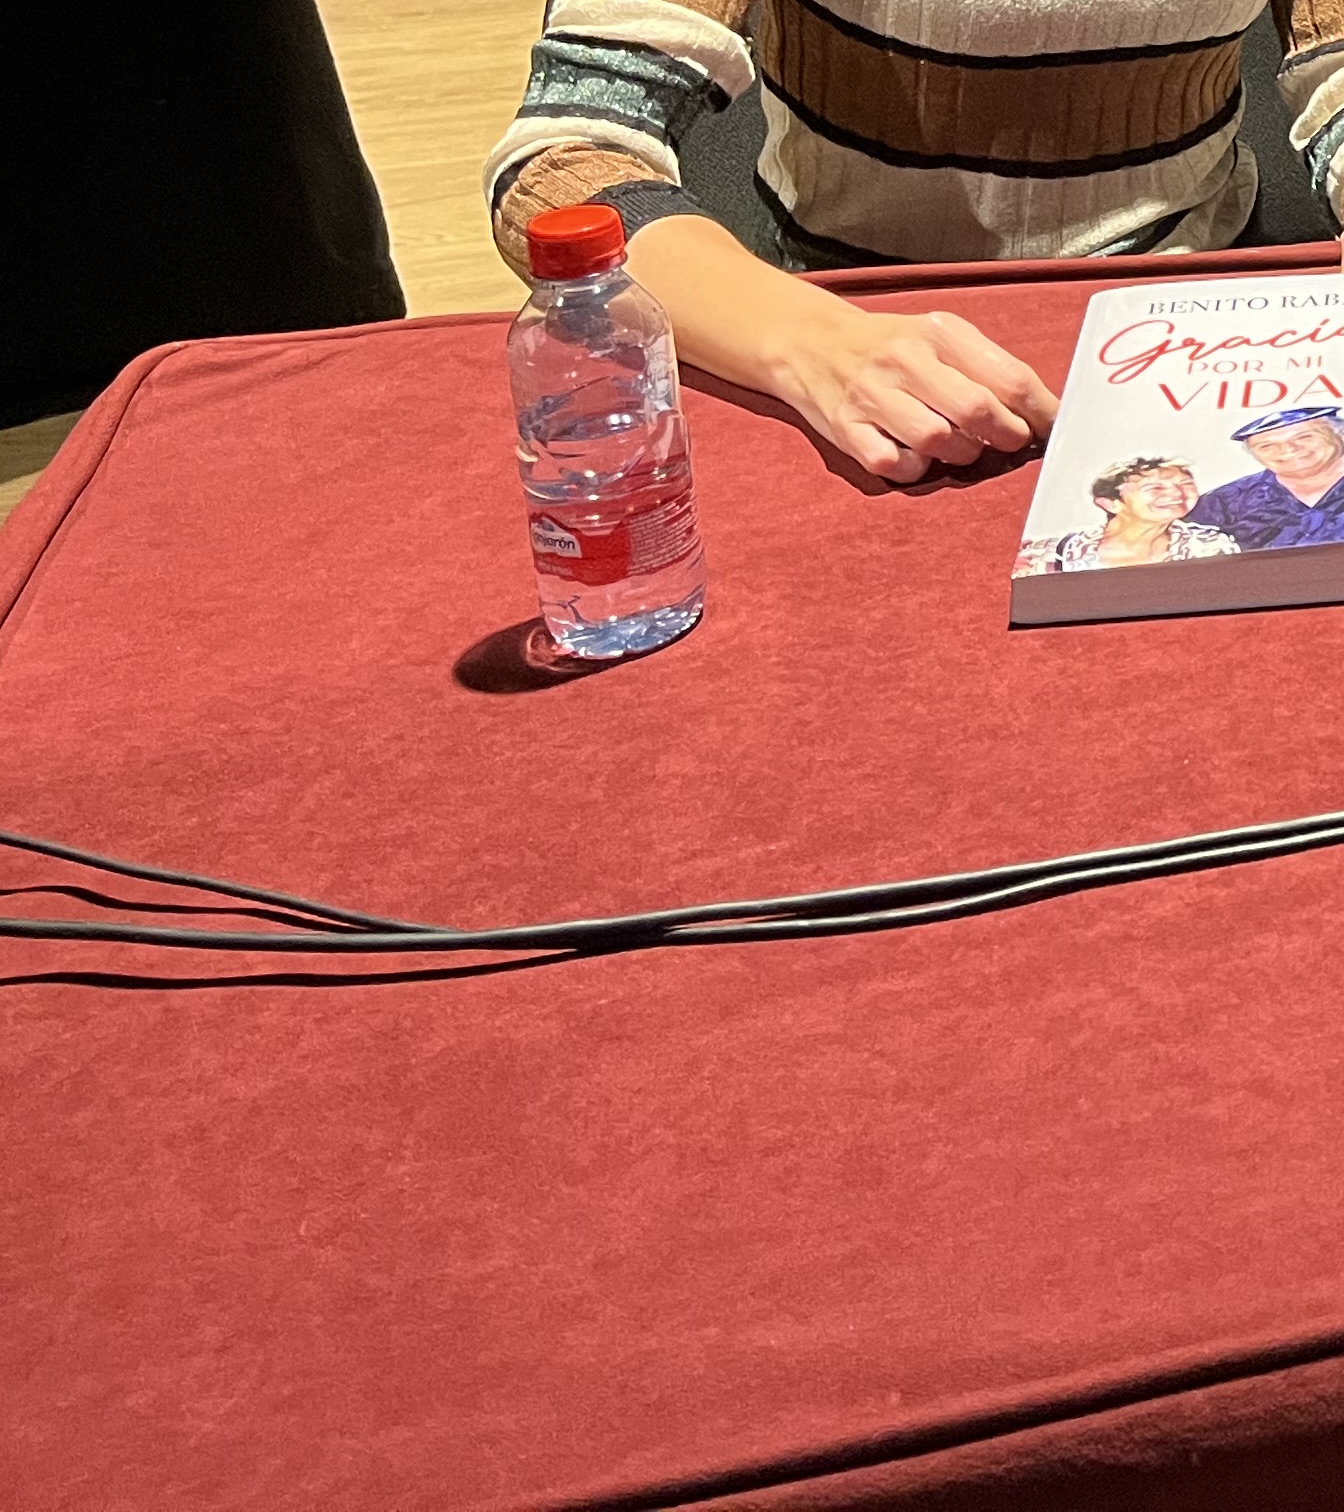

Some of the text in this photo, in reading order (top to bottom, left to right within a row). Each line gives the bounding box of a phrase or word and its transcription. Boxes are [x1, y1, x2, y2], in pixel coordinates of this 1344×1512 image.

[1147, 296, 1270, 316] BENITO
[1187, 355, 1324, 376] POR MI
[1157, 374, 1344, 412] VIDA
